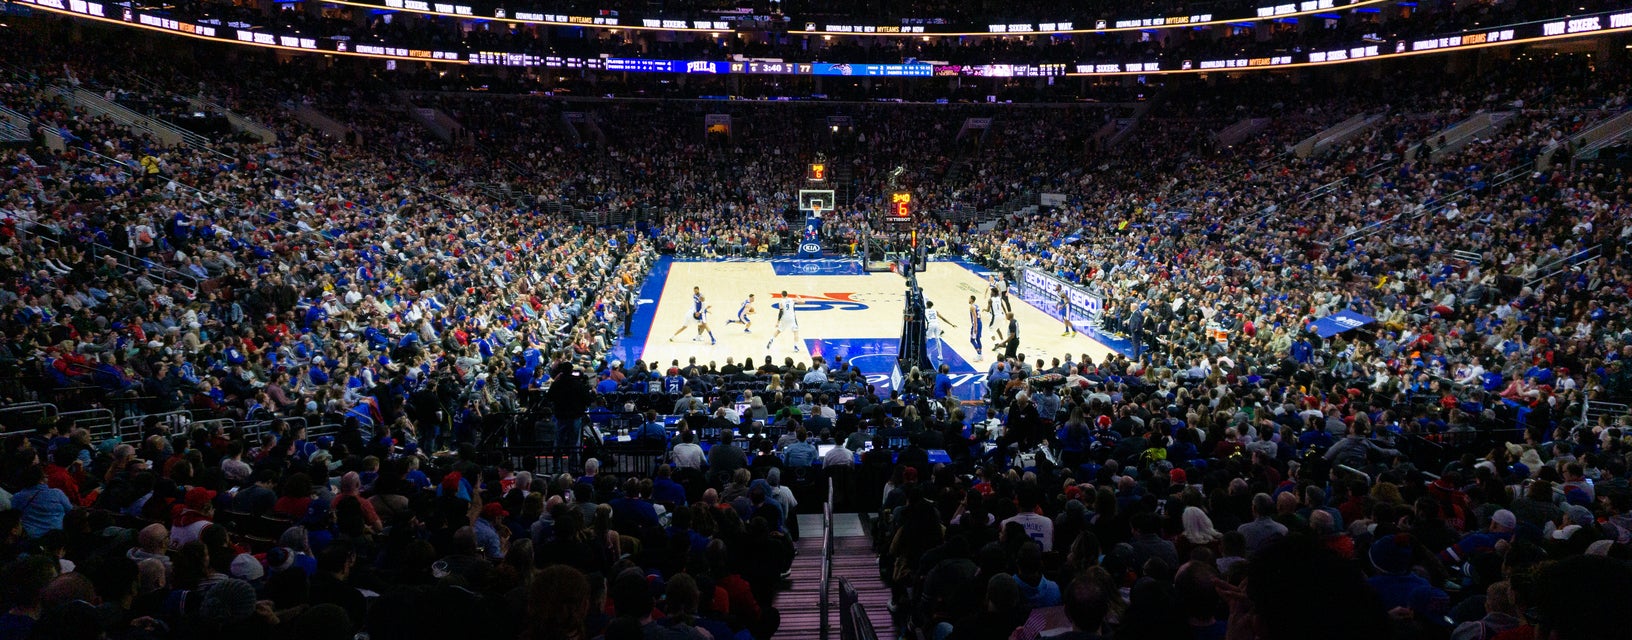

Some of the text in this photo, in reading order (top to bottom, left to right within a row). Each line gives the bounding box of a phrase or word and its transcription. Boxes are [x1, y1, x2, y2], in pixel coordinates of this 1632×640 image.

[435, 4, 453, 13] YOUR
[516, 12, 543, 20] DOWNLOAD
[570, 16, 592, 24] MYTEAMS
[643, 19, 660, 27] YOUR
[663, 20, 688, 28] SIXERS.
[694, 21, 711, 29] YOUR
[1116, 20, 1141, 28] DOWNLOAD
[1166, 16, 1189, 24] MYTEAMS
[1008, 24, 1033, 32] SIXERS.
[1544, 22, 1565, 35] YOUR
[1568, 17, 1601, 32] SIXERS.
[280, 36, 299, 47] YOUR
[1462, 34, 1486, 44] MYTEAMS
[1487, 32, 1499, 42] APP
[356, 45, 384, 54] DOWNLOAD
[409, 50, 431, 58] MYTEAMS
[433, 51, 444, 59] APP
[687, 61, 716, 73] PHILA
[1077, 65, 1094, 73] YOUR
[1096, 64, 1120, 72] SIXERS.
[1144, 63, 1160, 71] WAY.
[1249, 58, 1271, 66] MYTEAMS
[900, 202, 908, 216] 6
[1026, 270, 1046, 290] GEICO
[1071, 290, 1097, 313] GEICO
[670, 384, 678, 392] 21
